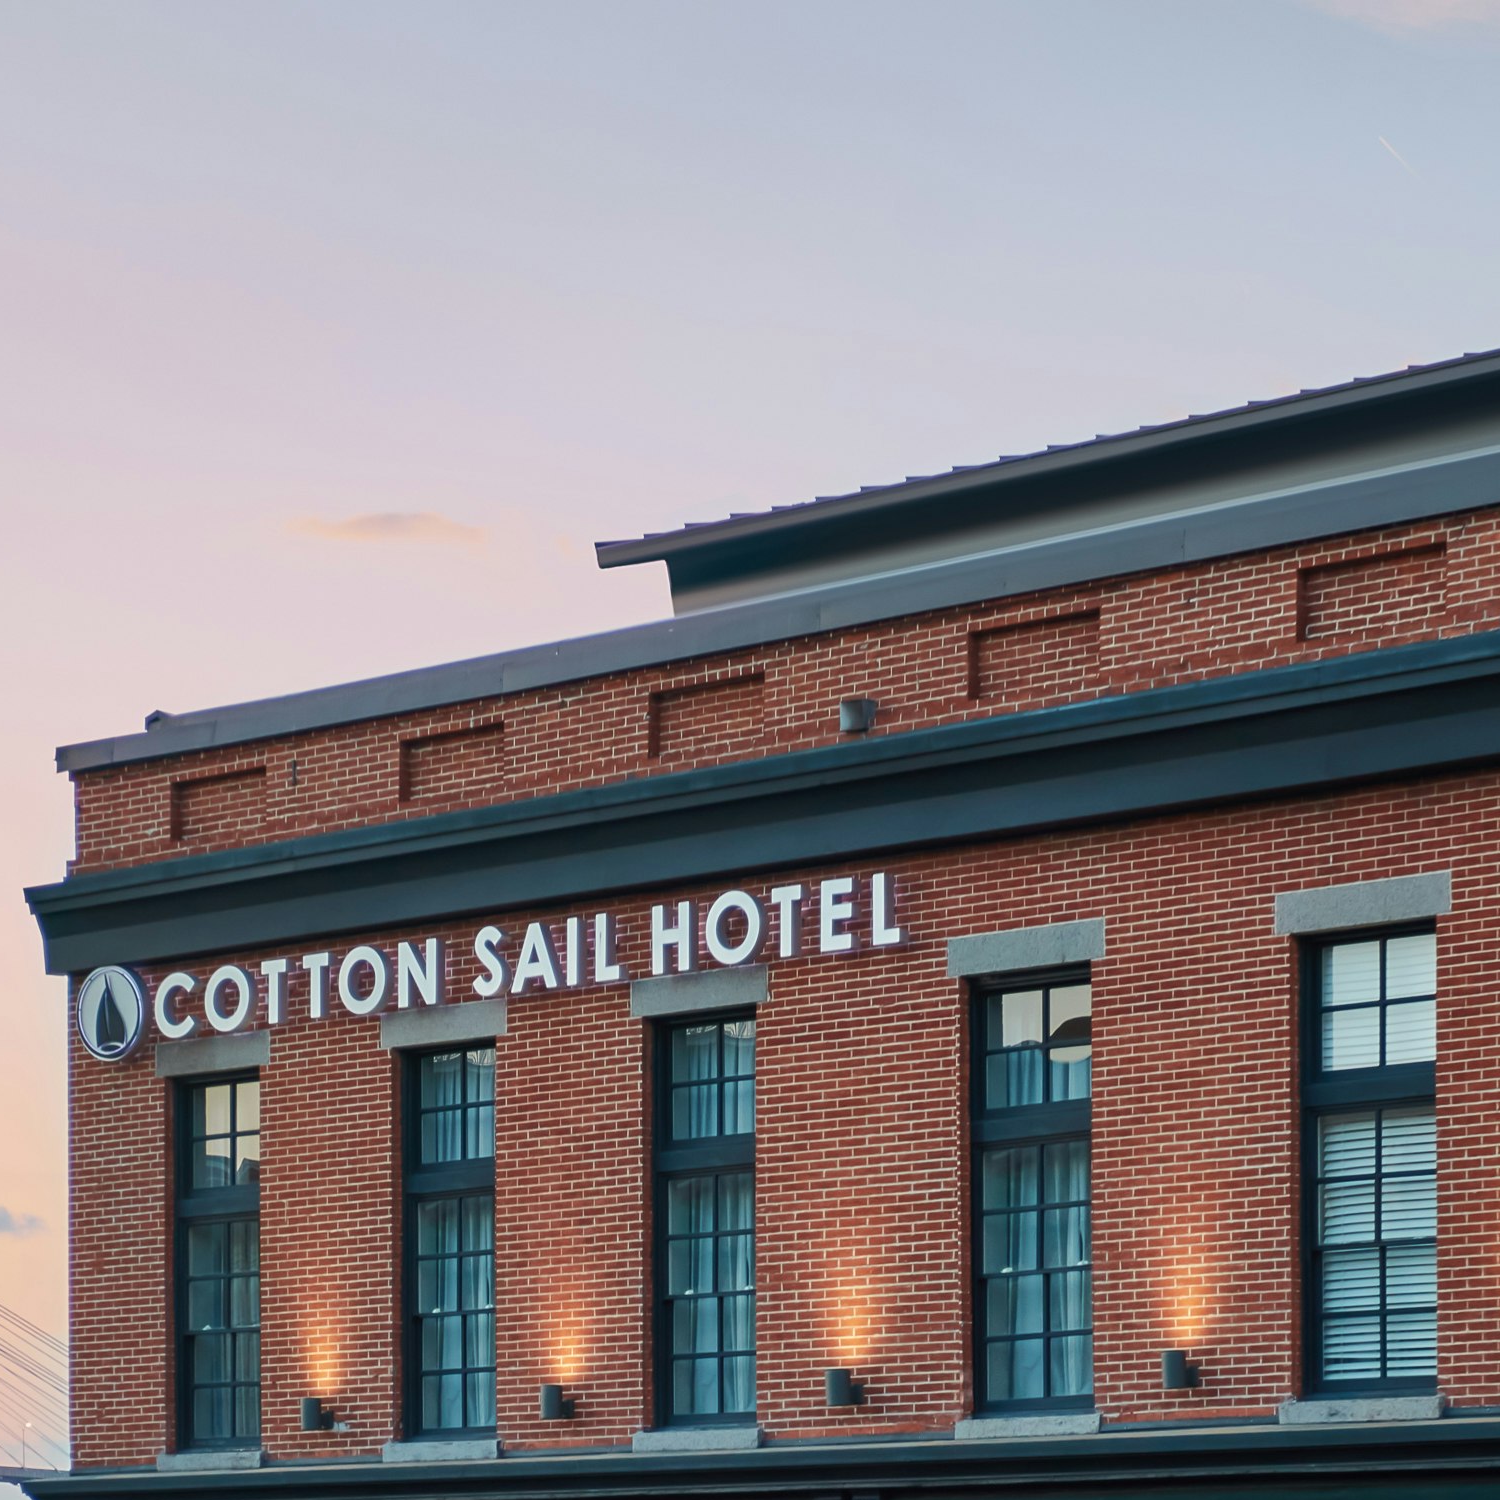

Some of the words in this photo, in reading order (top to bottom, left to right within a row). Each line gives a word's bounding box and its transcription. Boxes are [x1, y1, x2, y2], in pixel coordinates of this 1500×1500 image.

[154, 938, 440, 1039] COTTON
[472, 912, 622, 997] SAIL
[651, 872, 901, 976] HOTEL
